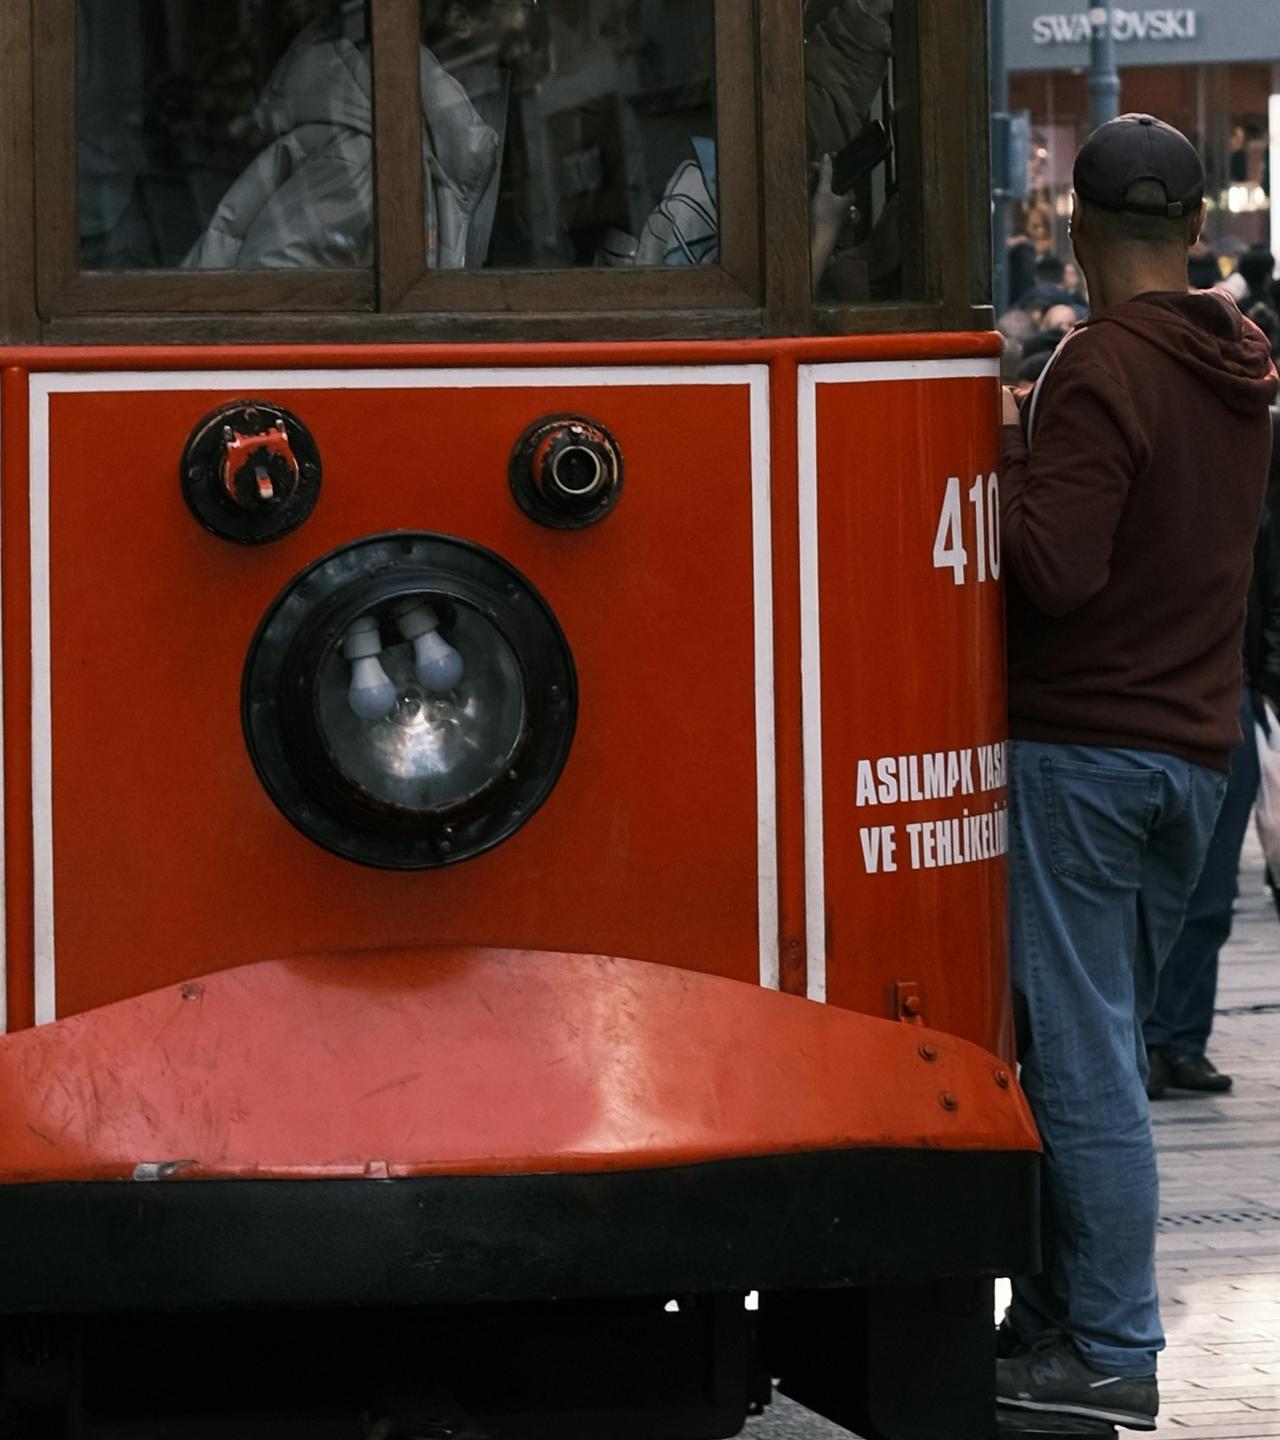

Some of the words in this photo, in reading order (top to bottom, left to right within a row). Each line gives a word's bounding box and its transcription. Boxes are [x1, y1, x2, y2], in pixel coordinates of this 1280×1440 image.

[1032, 8, 1195, 44] SWAOVSKI
[933, 471, 1000, 585] 410
[855, 748, 975, 807] ASILMAK
[859, 825, 898, 874] VE
